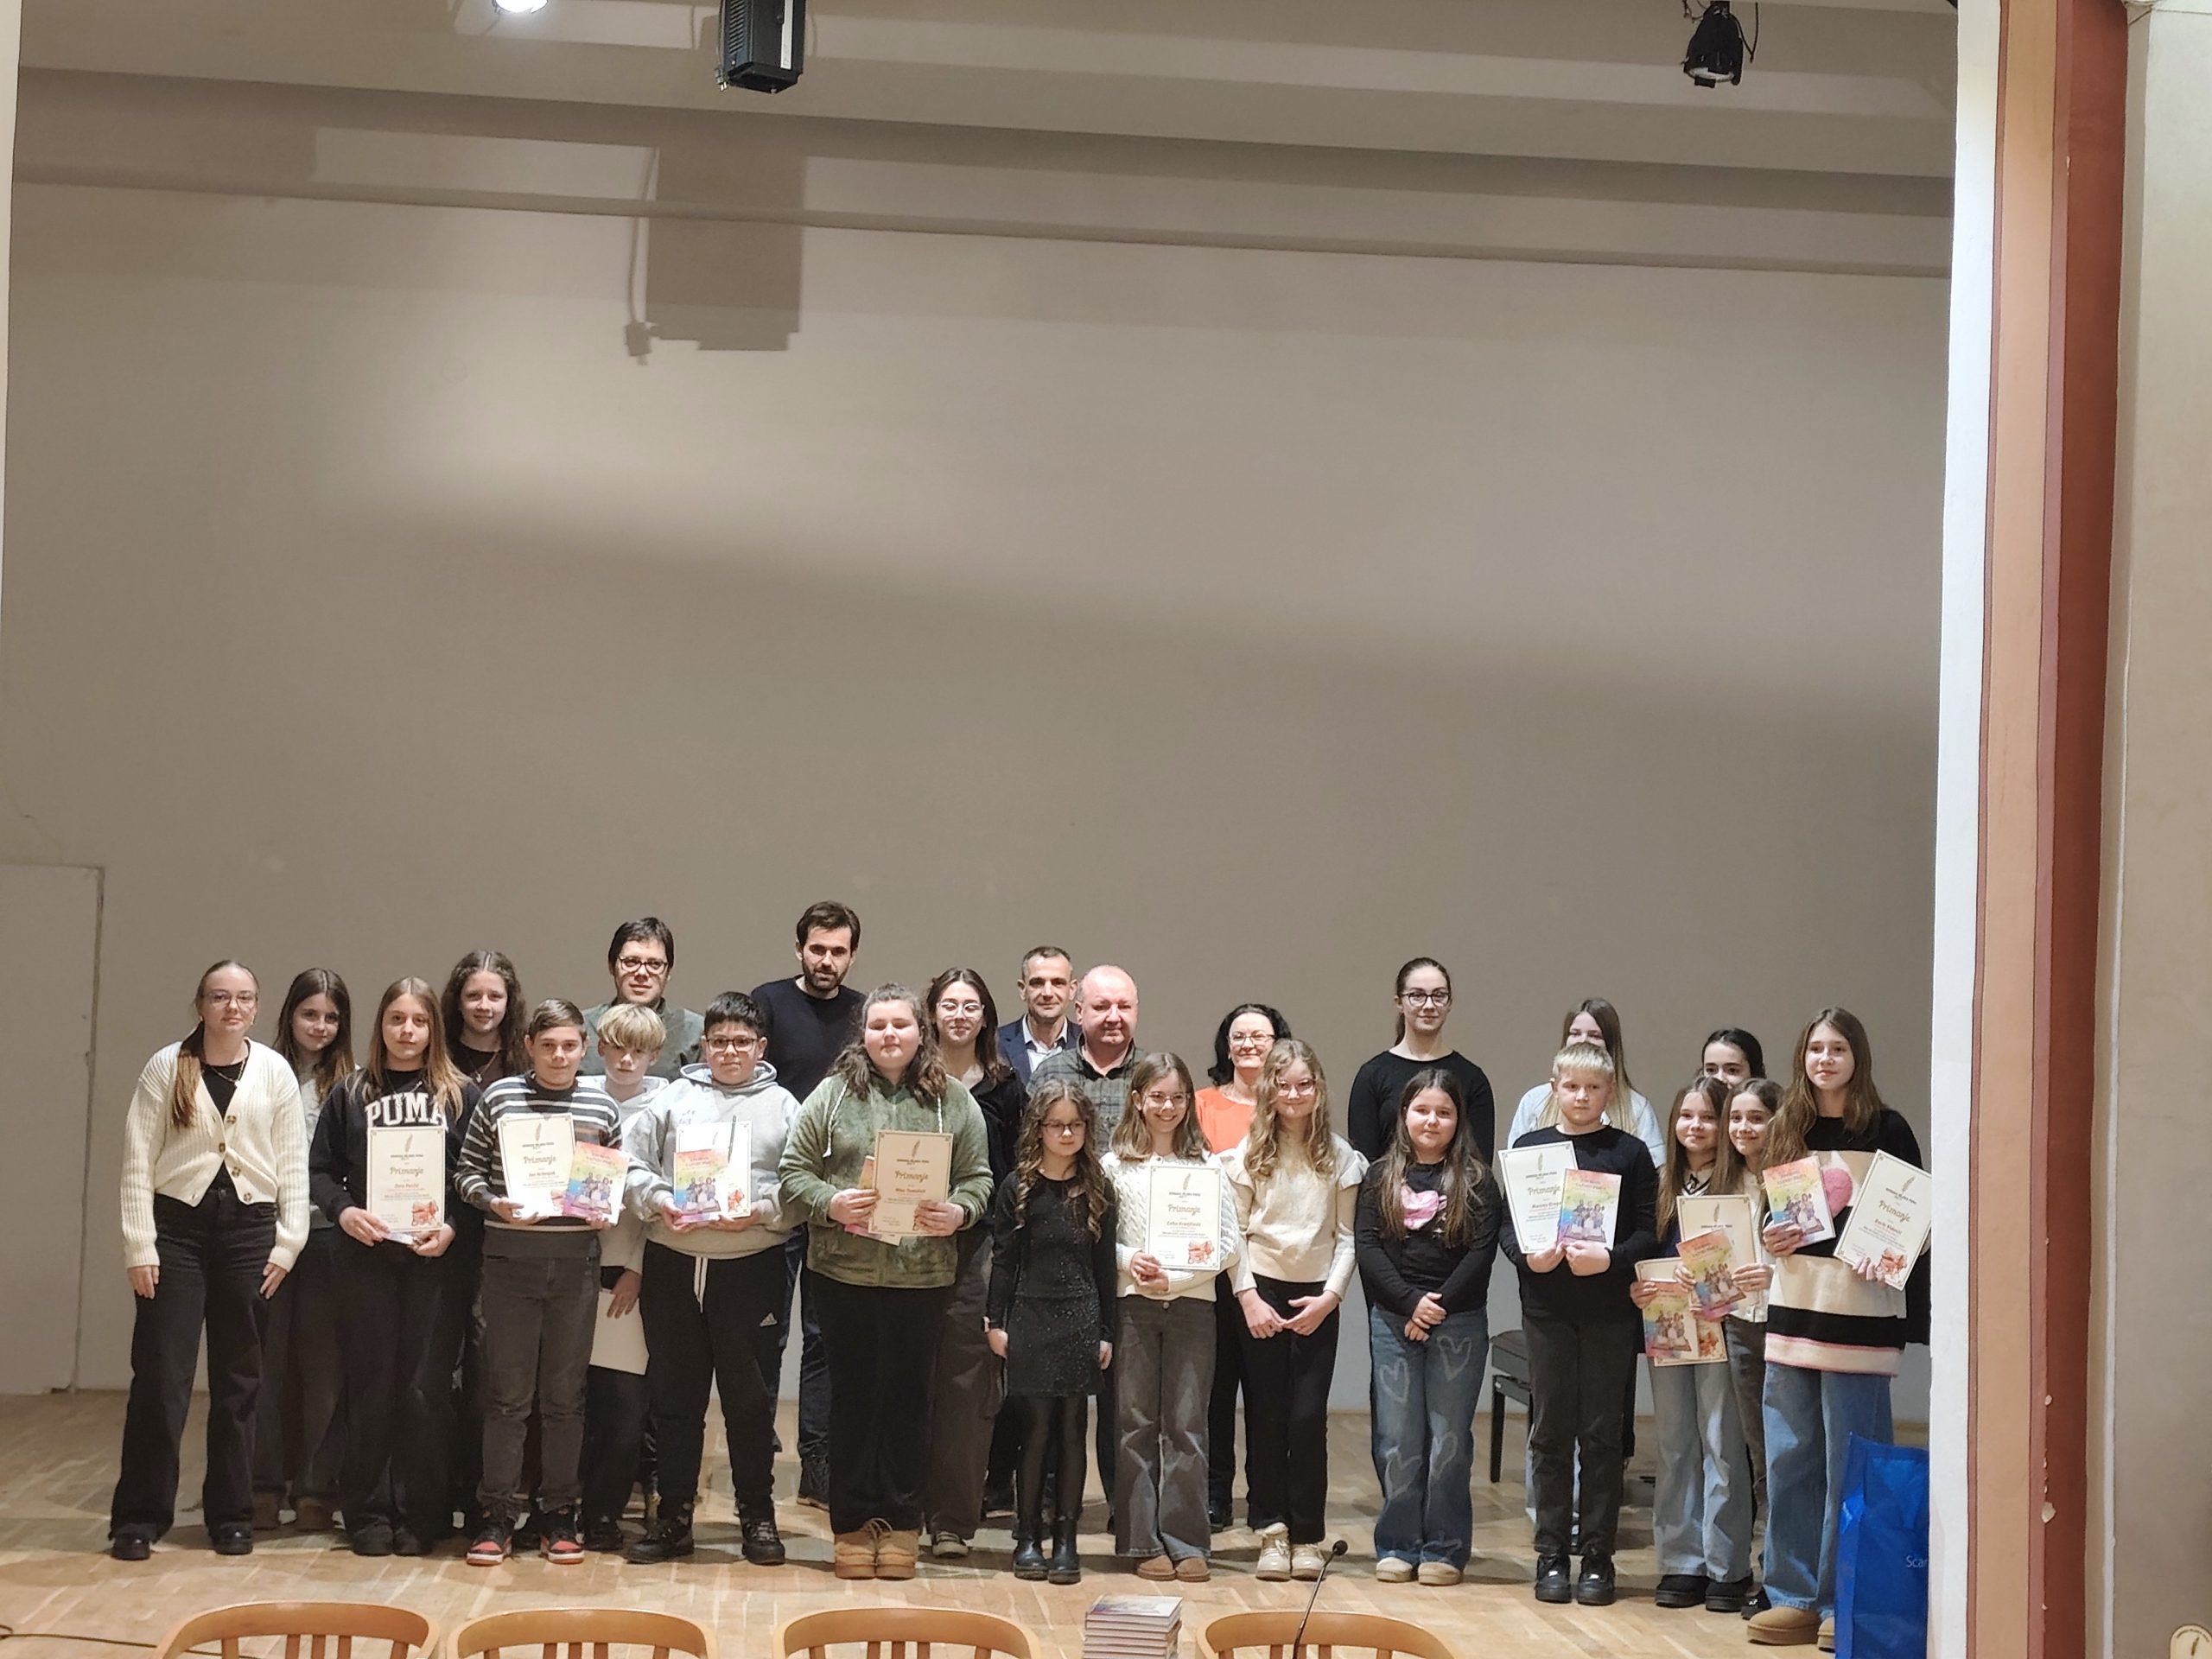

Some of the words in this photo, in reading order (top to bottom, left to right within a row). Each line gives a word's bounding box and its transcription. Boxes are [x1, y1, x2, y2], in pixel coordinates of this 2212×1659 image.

[365, 1091, 448, 1131] PUMA
[390, 1166, 423, 1177] Priznanje
[895, 1170, 928, 1183] Priznanje
[1528, 1184, 1560, 1196] Priznanje
[1878, 1200, 1910, 1223] Priznanje
